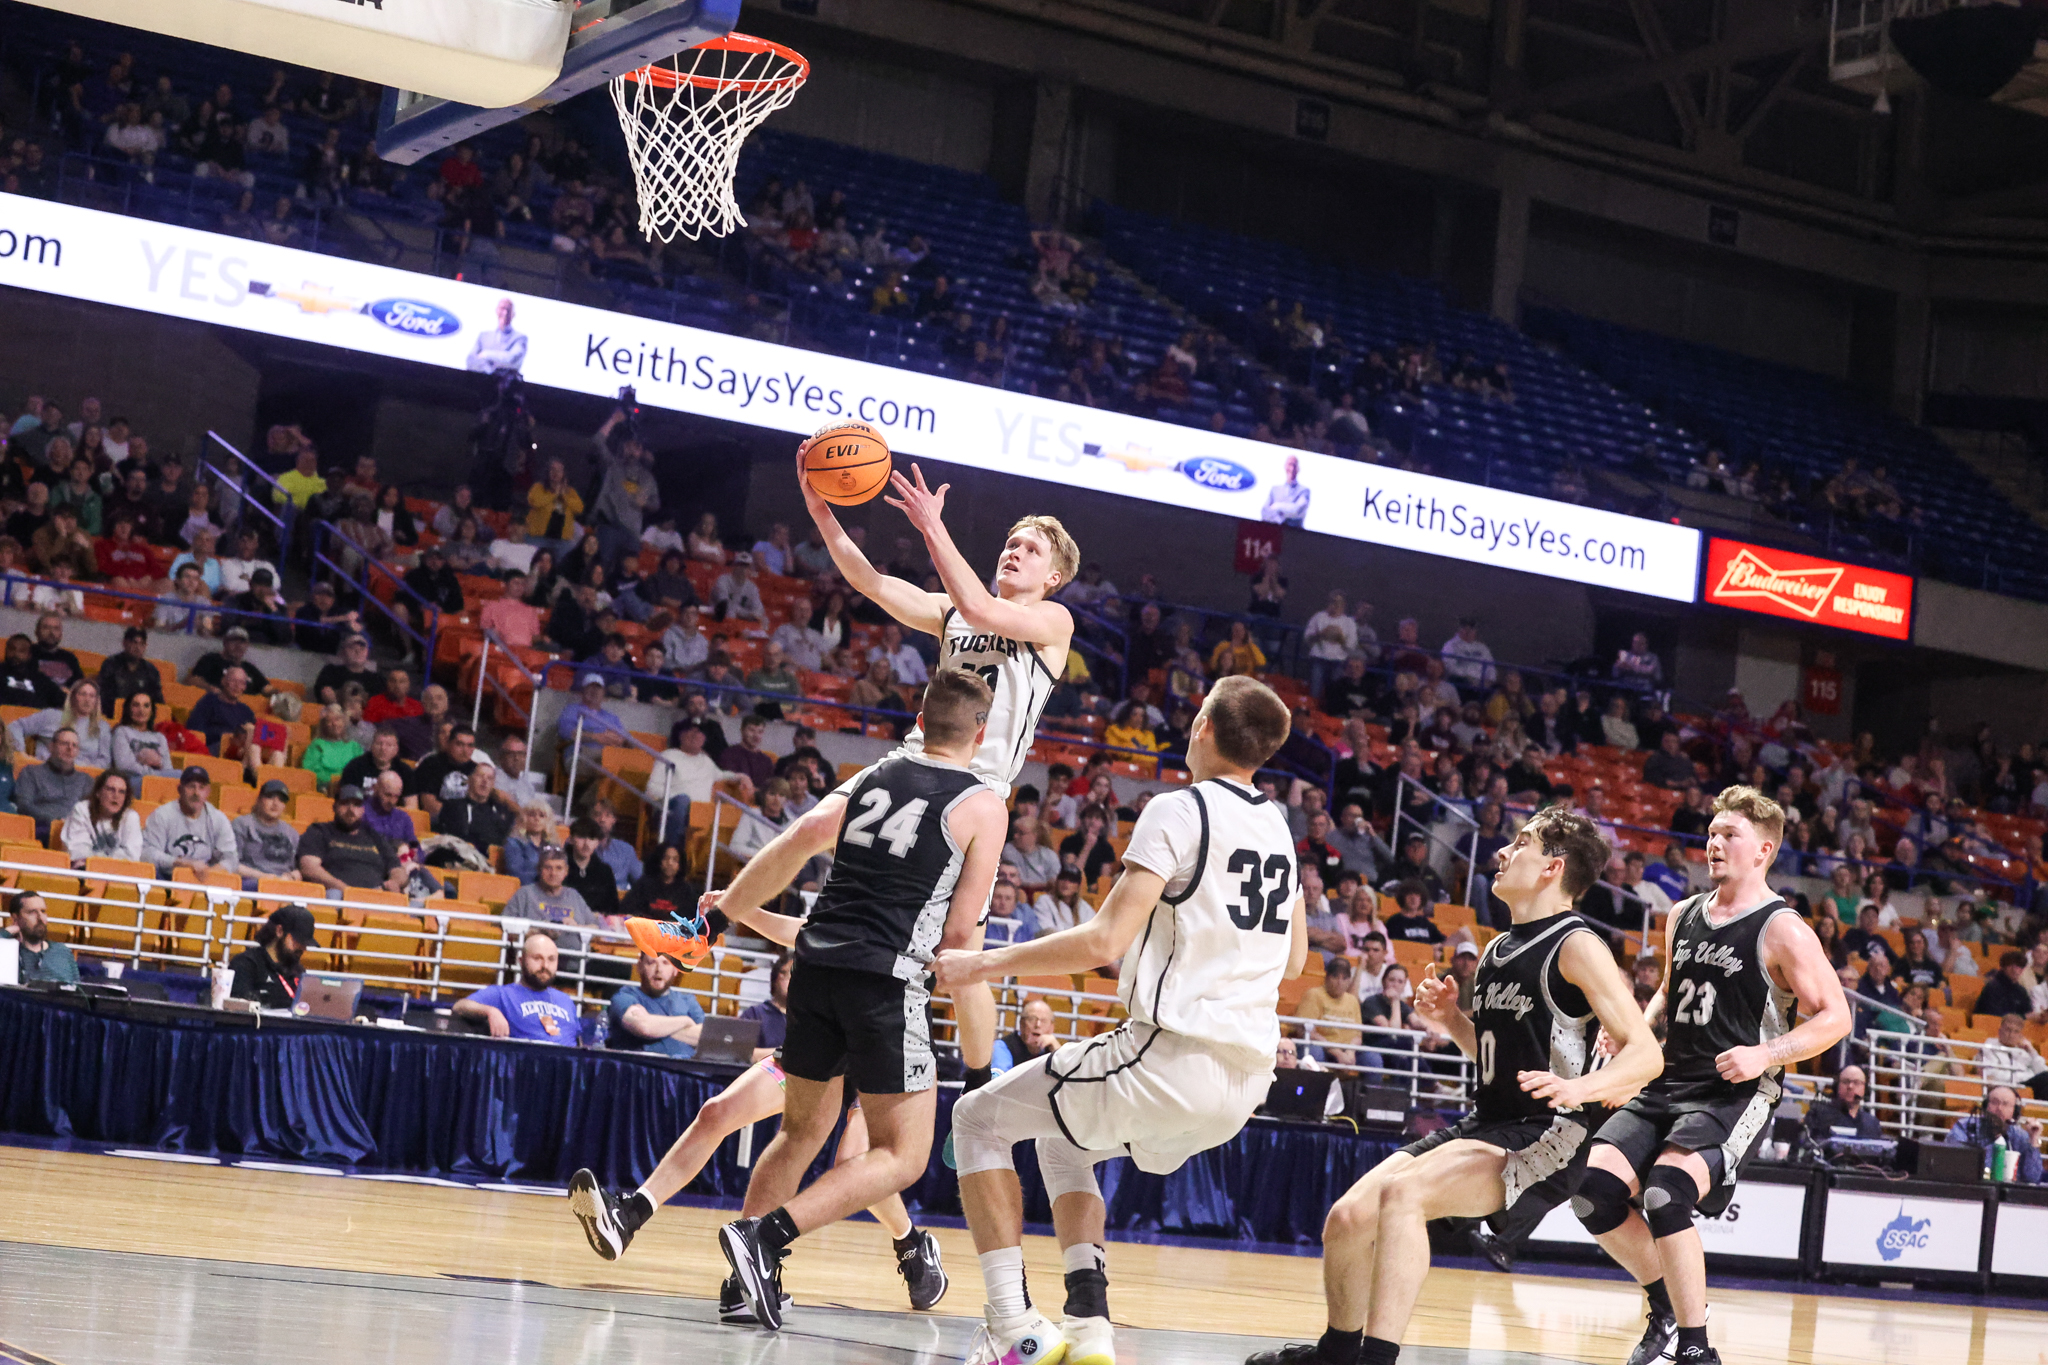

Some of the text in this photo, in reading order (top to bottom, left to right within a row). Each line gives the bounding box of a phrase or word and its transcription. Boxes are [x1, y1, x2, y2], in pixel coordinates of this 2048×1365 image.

[140, 239, 249, 308] YES
[385, 301, 445, 335] Ford
[584, 333, 936, 433] KeithSaysYes.com
[995, 407, 1083, 467] YES
[1194, 459, 1243, 489] Ford
[1363, 487, 1645, 571] KeithSaysYes.com
[1244, 537, 1273, 559] 114
[1727, 559, 1829, 600] Budweiser
[1853, 582, 1887, 604] ENJOY
[1833, 595, 1904, 624] RESPONSIBLY
[949, 633, 1020, 663] TUCKER
[1811, 679, 1837, 701] 115
[843, 786, 929, 859] 24
[1226, 848, 1291, 935] 32
[1694, 941, 1743, 978] Valley
[1484, 981, 1535, 1021] Valley
[1675, 978, 1717, 1027] 23
[912, 1062, 928, 1076] TV
[1885, 1230, 1929, 1249] SSAC
